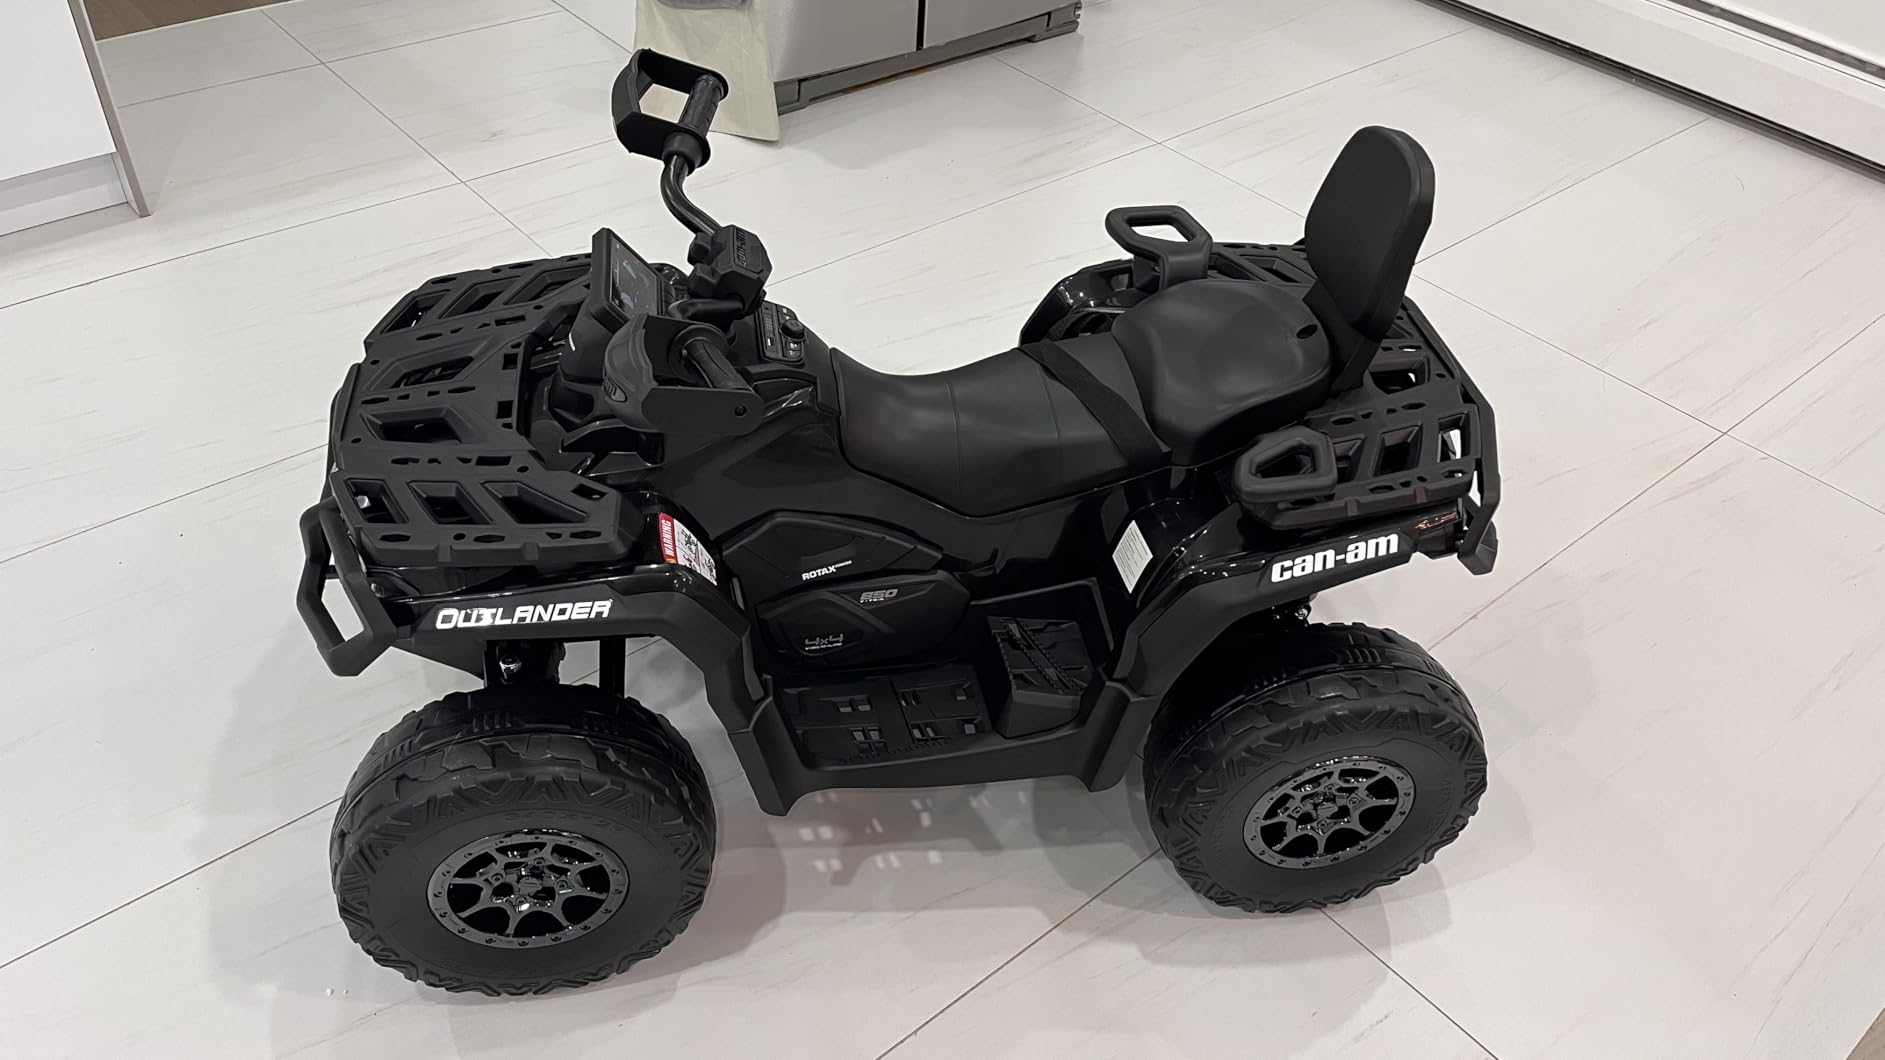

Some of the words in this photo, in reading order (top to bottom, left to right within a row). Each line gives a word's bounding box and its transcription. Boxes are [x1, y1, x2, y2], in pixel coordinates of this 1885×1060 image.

[661, 519, 674, 556] WARNING
[801, 565, 836, 581] ROTAX
[1271, 533, 1399, 583] can-am
[435, 599, 612, 630] OUTLANDER
[805, 633, 844, 646] 4x4
